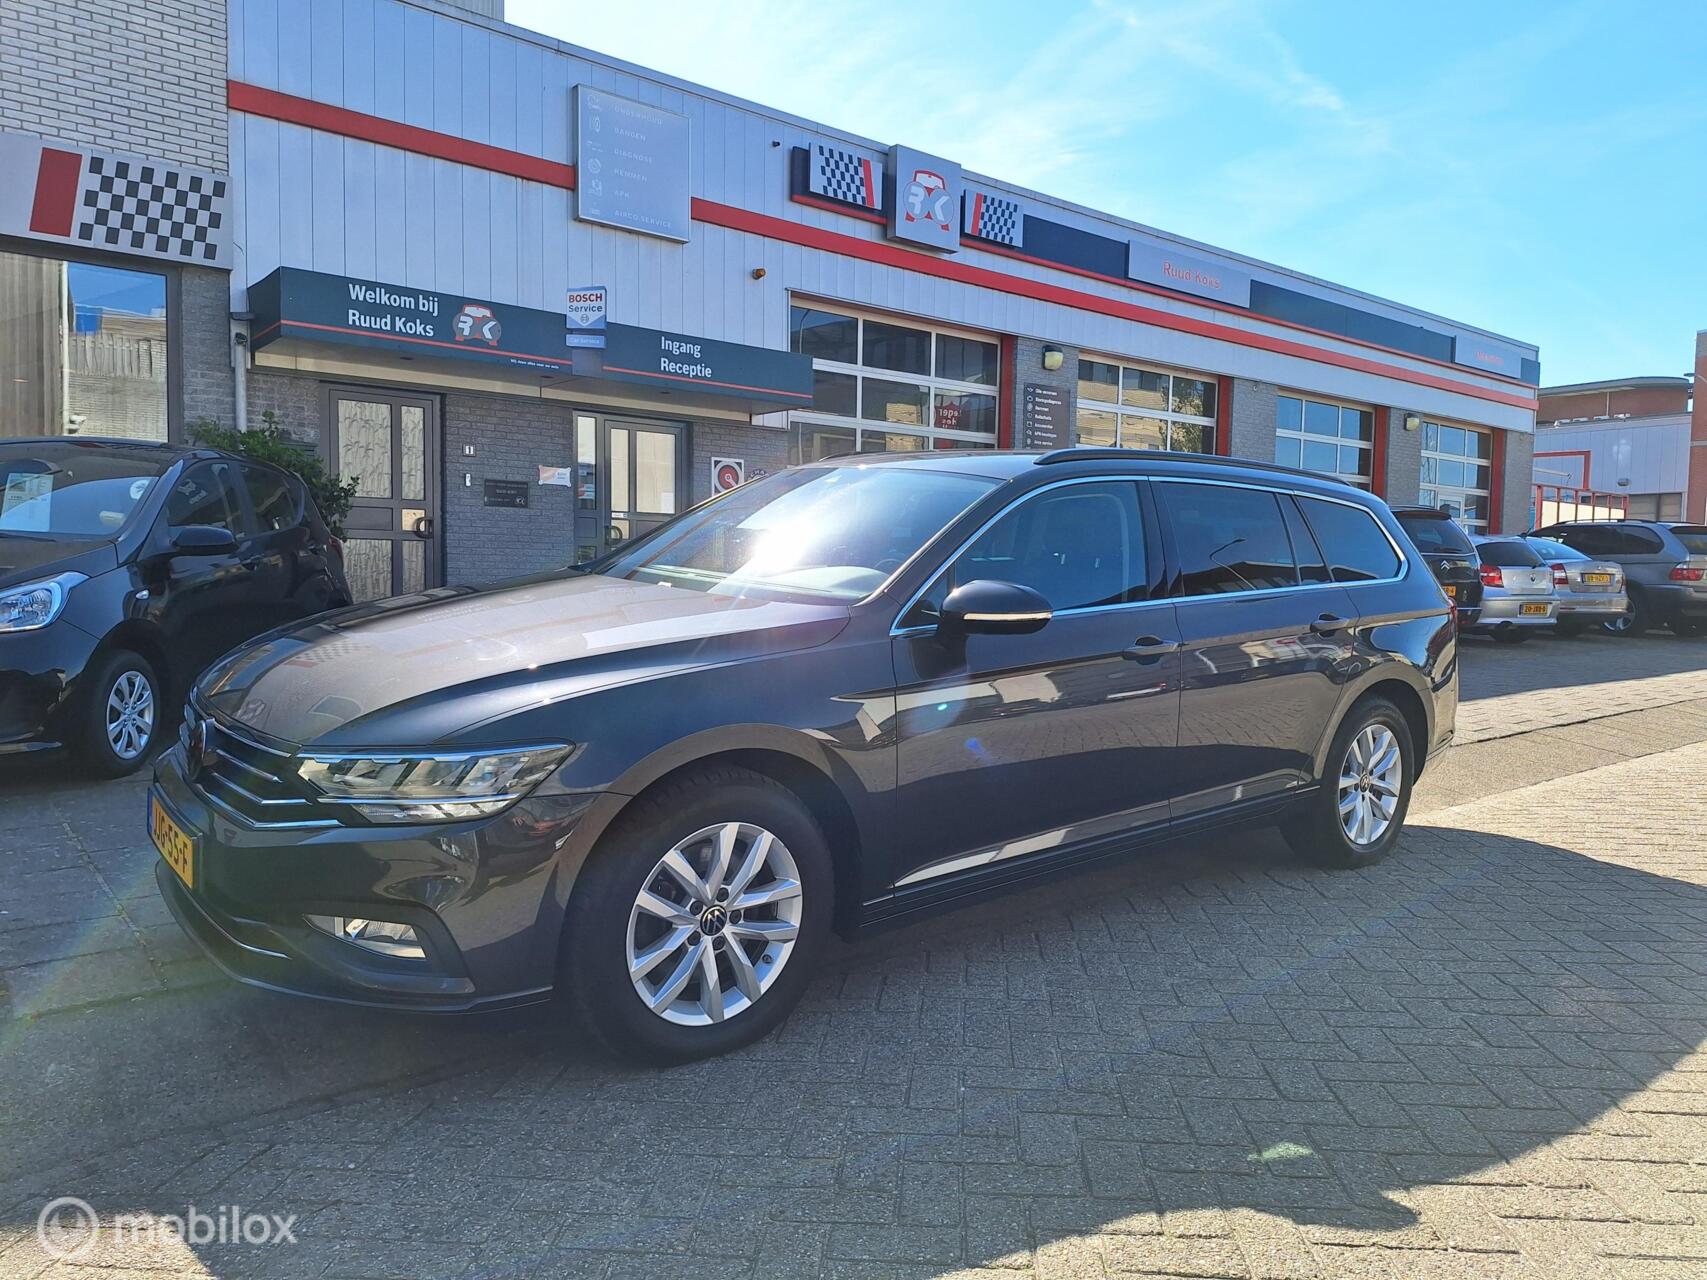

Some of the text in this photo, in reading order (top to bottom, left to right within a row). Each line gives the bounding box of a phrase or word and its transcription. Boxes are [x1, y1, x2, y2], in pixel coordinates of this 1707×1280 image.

[640, 215, 672, 228] SERVICE
[1163, 262, 1191, 280] Ruud
[348, 283, 439, 317] Welkom bij
[568, 293, 603, 303] BOSCH
[568, 304, 603, 313] Service
[348, 309, 434, 337] Ruud Koks
[661, 336, 701, 358] Ingang
[660, 357, 712, 378] Receptie
